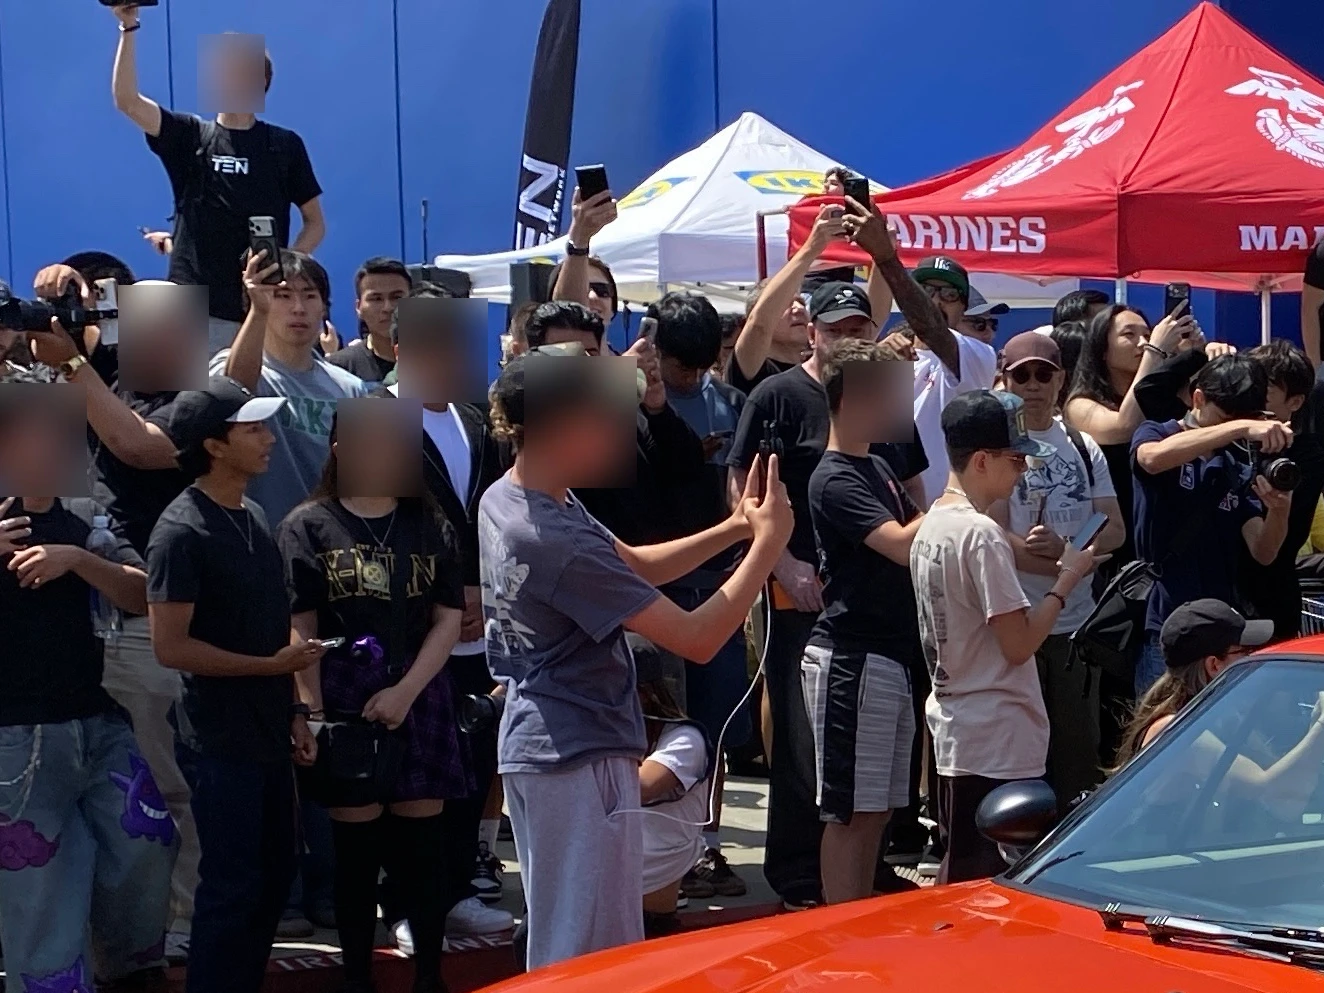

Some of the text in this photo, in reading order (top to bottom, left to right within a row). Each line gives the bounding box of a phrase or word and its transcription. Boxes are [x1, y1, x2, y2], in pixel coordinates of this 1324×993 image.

[212, 154, 249, 174] TEN
[886, 214, 1046, 253] ARINES
[315, 548, 438, 602] X-MN
